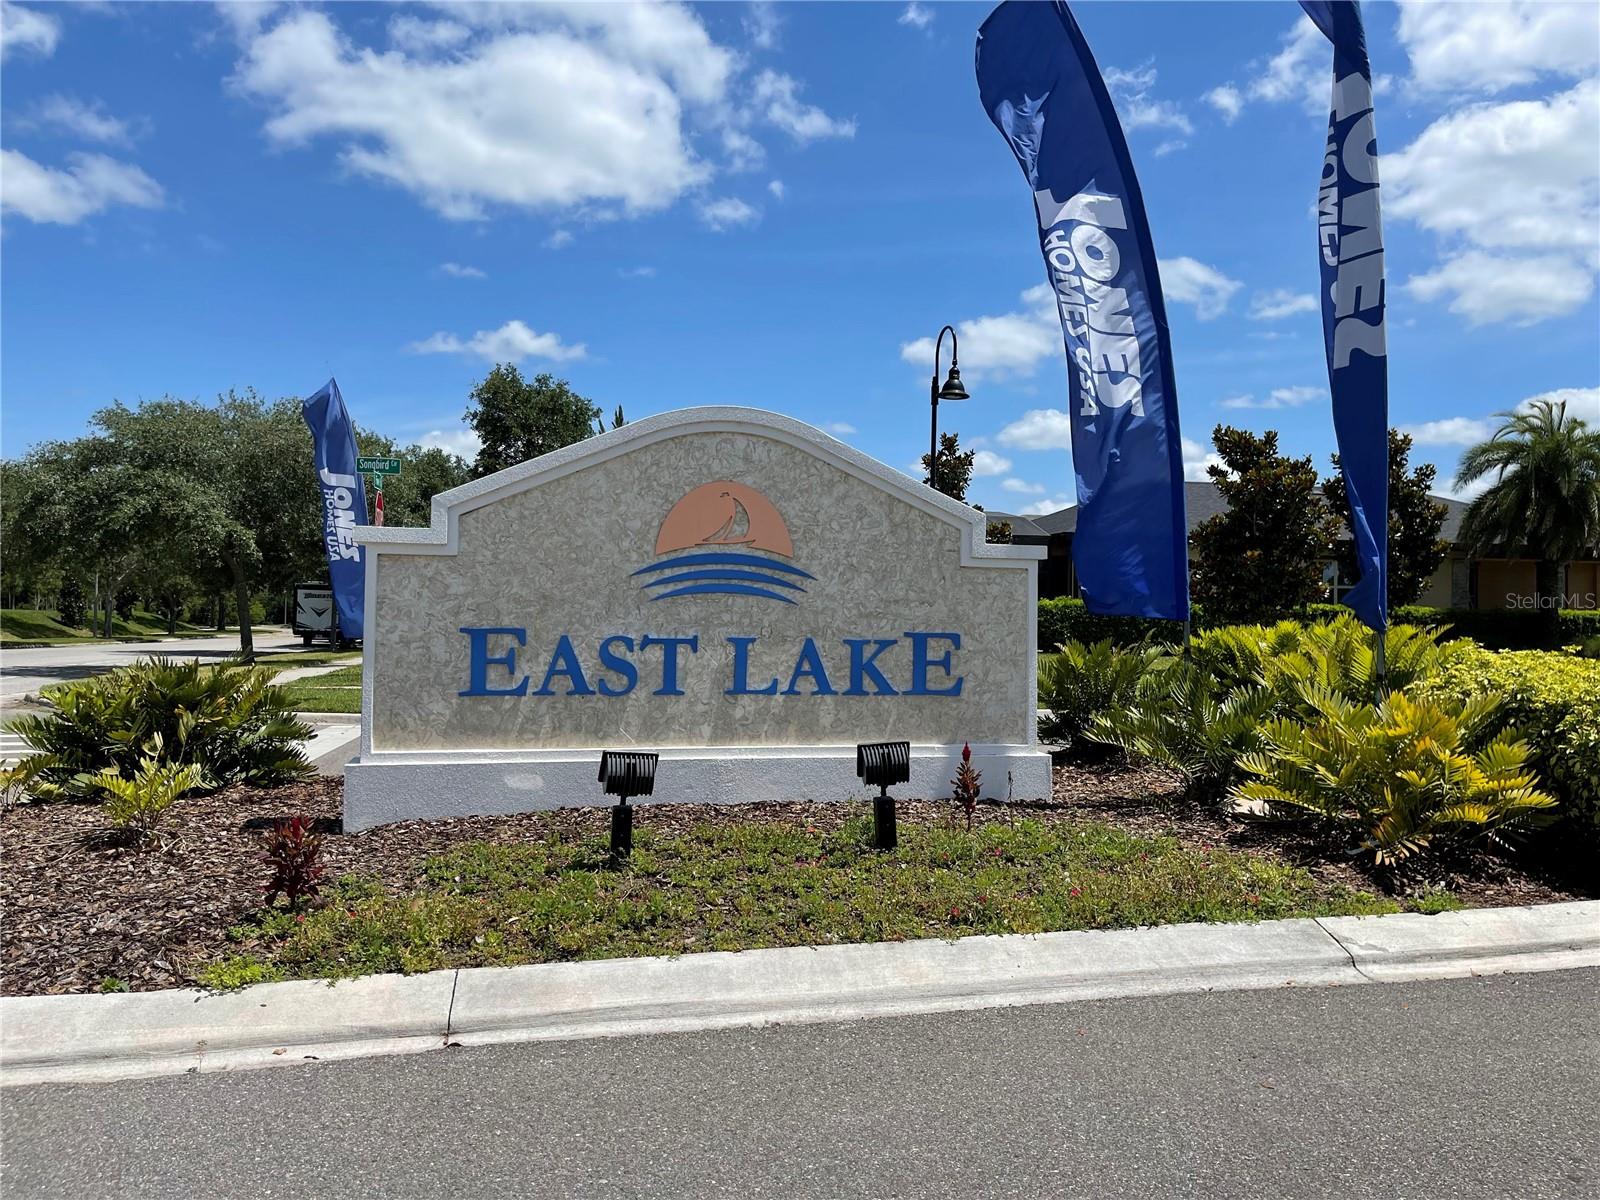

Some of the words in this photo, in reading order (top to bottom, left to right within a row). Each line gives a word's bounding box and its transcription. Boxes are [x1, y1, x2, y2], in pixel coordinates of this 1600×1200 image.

[1035, 188, 1144, 417] JONES
[1045, 229, 1089, 342] HOMES
[359, 458, 390, 470] Songbird
[319, 467, 360, 563] JONES
[323, 488, 336, 533] HOMES
[326, 535, 341, 561] USA
[458, 627, 698, 698] EAST
[725, 631, 964, 698] LAKE
